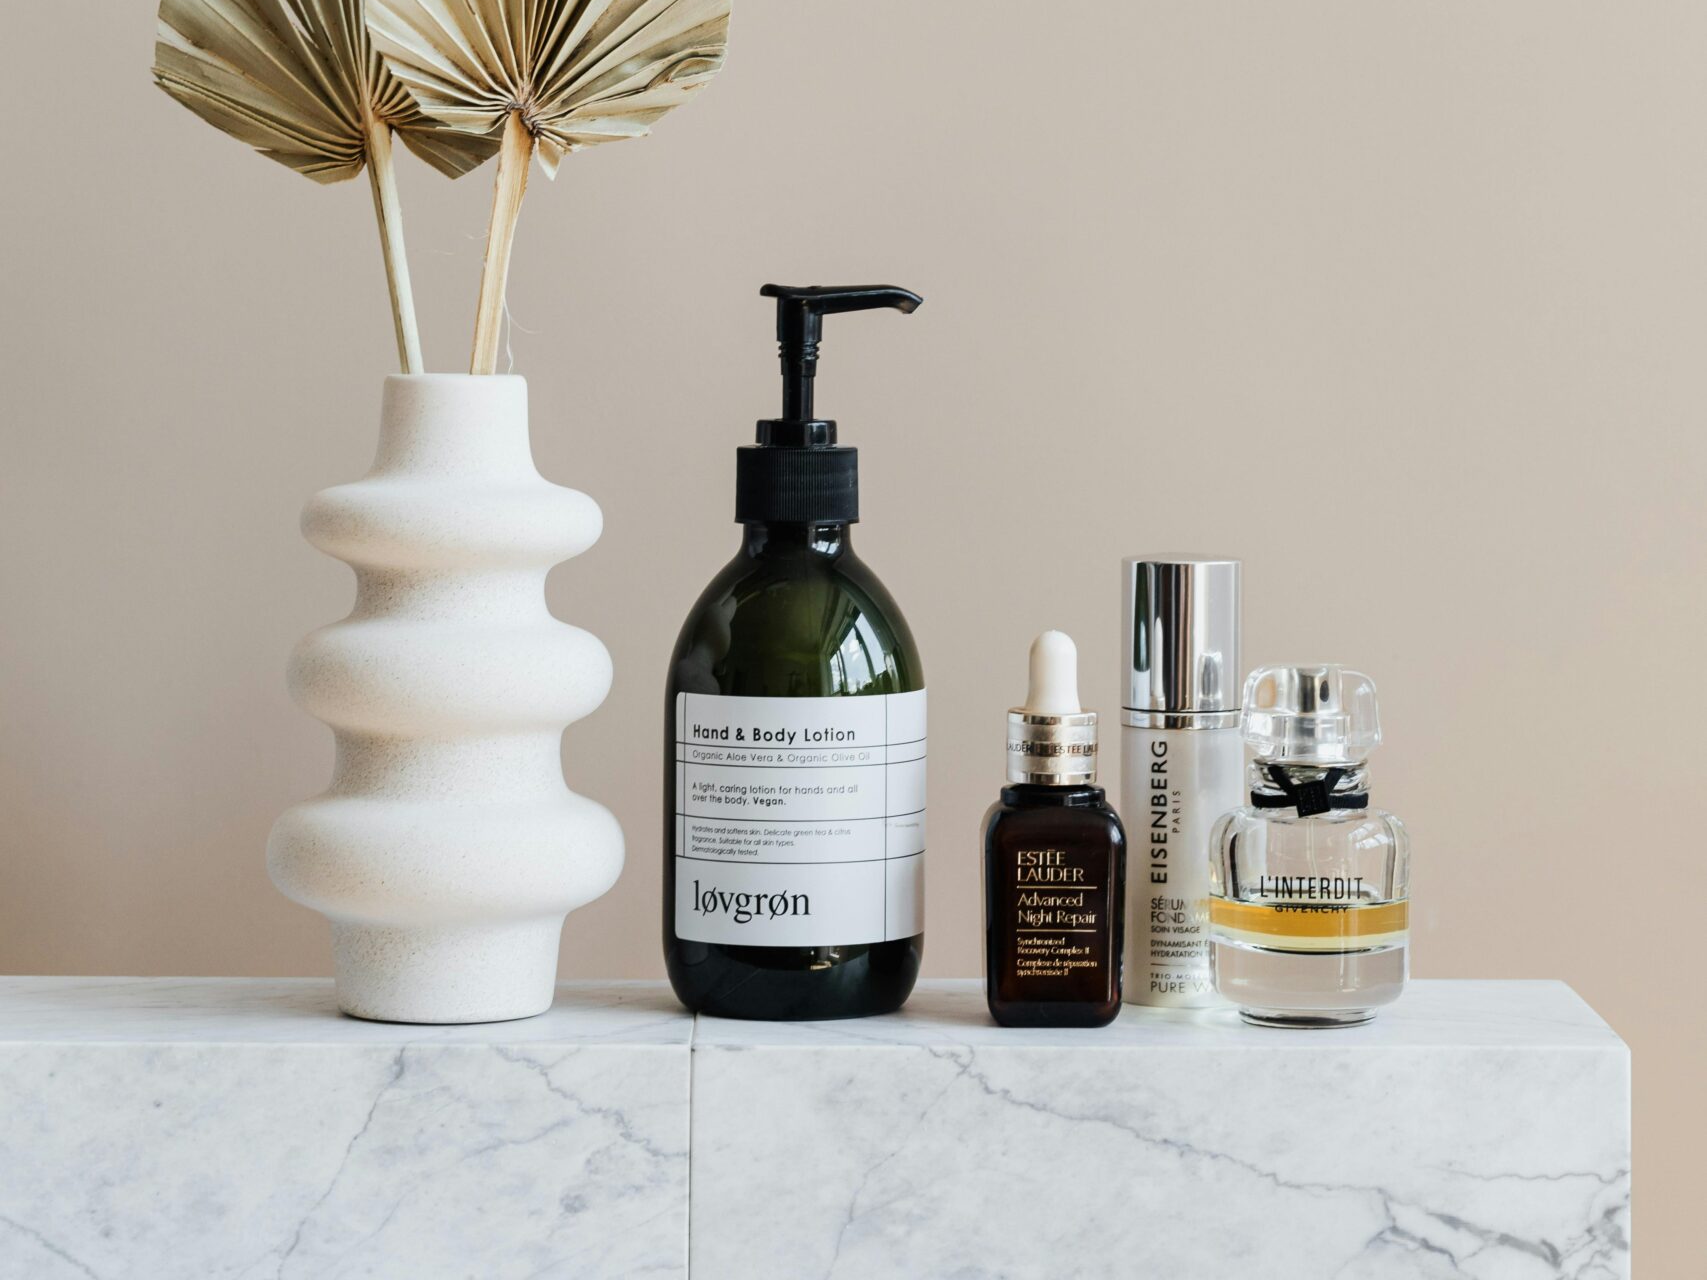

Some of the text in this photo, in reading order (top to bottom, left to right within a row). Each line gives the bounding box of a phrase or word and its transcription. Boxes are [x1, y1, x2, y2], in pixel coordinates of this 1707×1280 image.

[693, 724, 856, 745] Hand & Body Lotion
[692, 749, 871, 765] Organic Aloe Vera & Organic Olive Oil
[692, 782, 859, 796] A light, caring lotion for hands and all
[692, 794, 787, 807] over the body. Vegan.
[1151, 741, 1168, 884] EISENBERG
[1172, 791, 1180, 833] PARIS
[714, 826, 726, 834] and
[793, 829, 814, 837] green
[1017, 867, 1084, 882] LAUDER
[1261, 875, 1363, 900] L'INTERDIT
[693, 880, 812, 924] løvgrøn
[1017, 891, 1083, 907] Advanced
[1275, 904, 1349, 914] GIVENCHY
[1018, 909, 1097, 927] Night Repair
[1172, 925, 1200, 934] VISAGE
[1150, 981, 1185, 994] PURE
